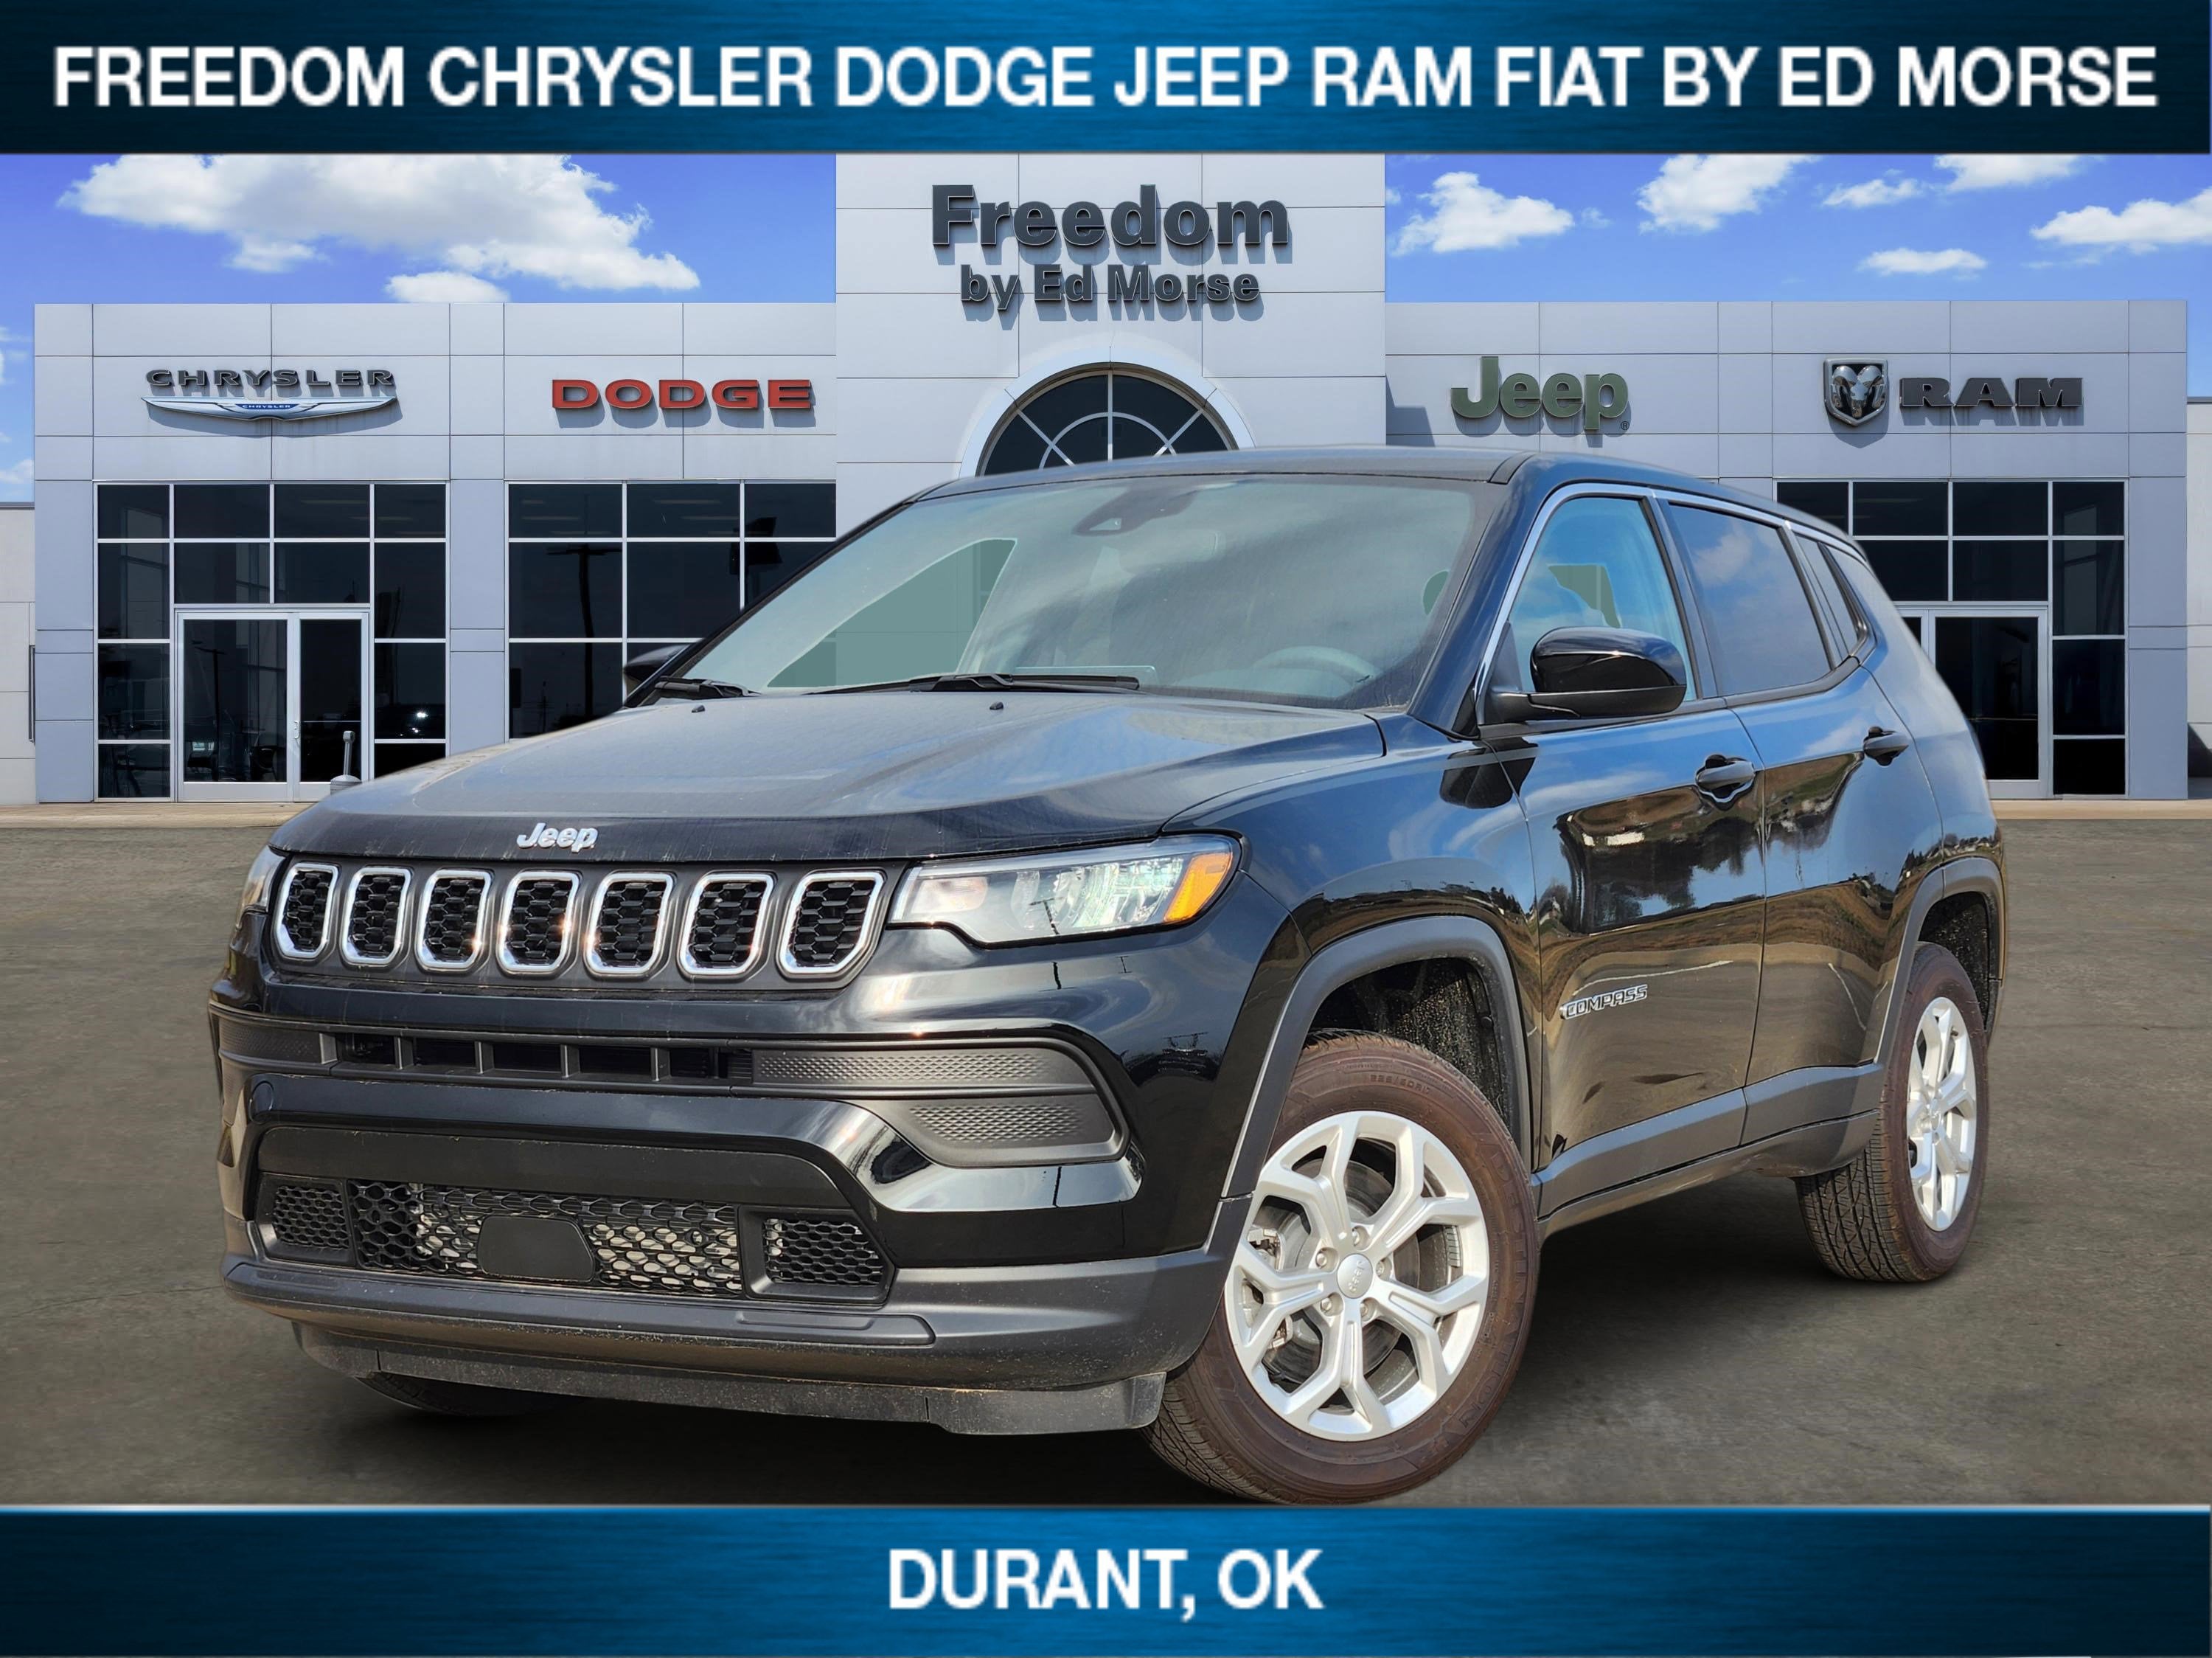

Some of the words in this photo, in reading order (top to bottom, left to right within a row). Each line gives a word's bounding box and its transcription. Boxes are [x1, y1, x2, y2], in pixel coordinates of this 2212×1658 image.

[931, 184, 1289, 246] Freedom
[960, 264, 1019, 311] by
[1034, 264, 1093, 301] Ed
[1107, 264, 1260, 302] Morse
[145, 369, 396, 387] CHRYSLER
[552, 378, 812, 409] DODGE
[1450, 355, 1629, 430] Jeep
[1899, 377, 2084, 408] RAM
[516, 822, 599, 853] Jeep
[1565, 984, 1649, 1019] COMPASS
